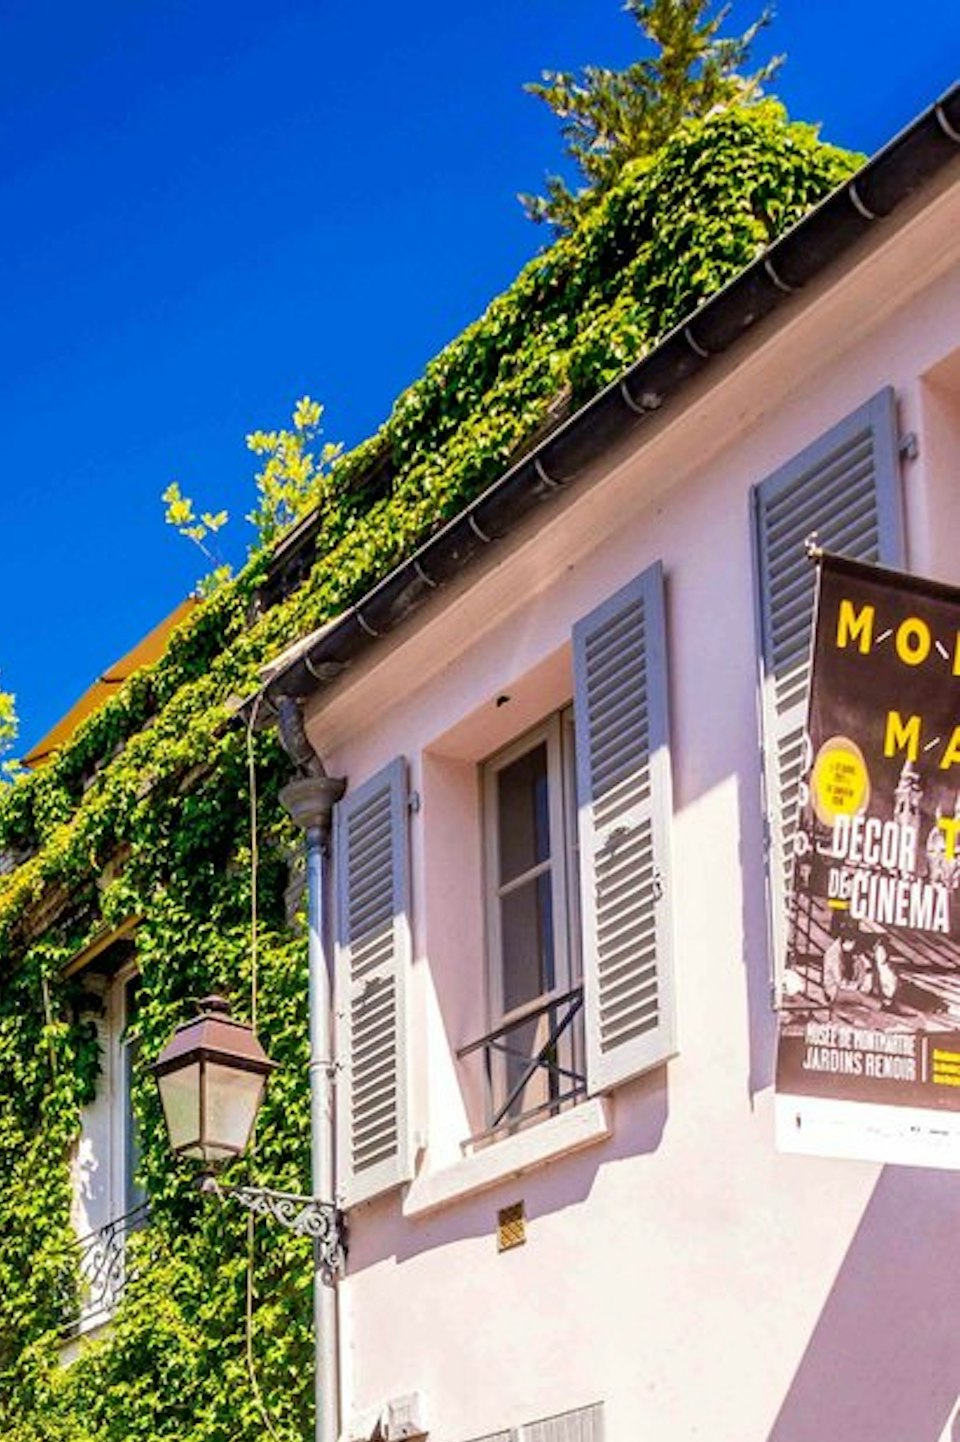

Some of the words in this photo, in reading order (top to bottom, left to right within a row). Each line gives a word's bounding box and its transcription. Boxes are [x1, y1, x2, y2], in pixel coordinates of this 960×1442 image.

[832, 810, 917, 872] DÉCOR
[828, 868, 851, 899] DE
[838, 1025, 851, 1049] DE
[802, 1046, 863, 1075] JARDINS
[865, 1053, 916, 1081] RENOIR
